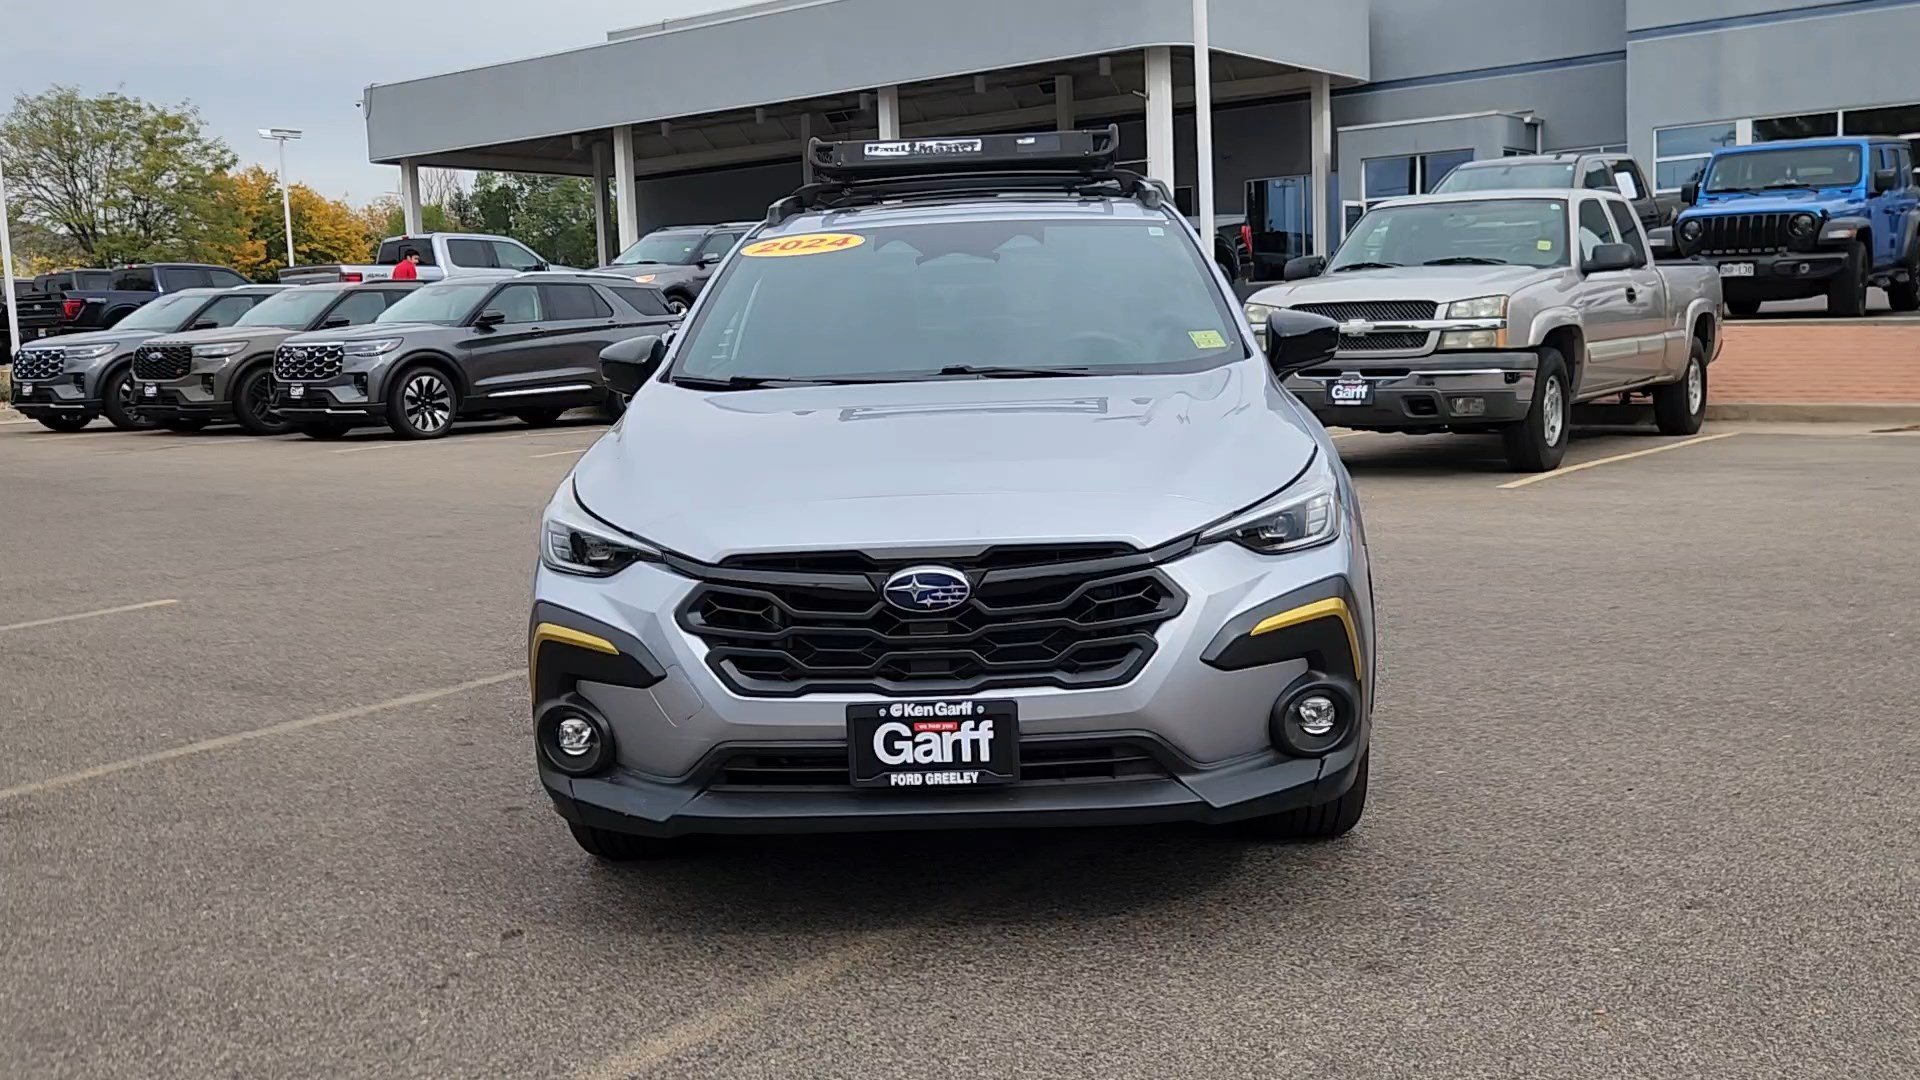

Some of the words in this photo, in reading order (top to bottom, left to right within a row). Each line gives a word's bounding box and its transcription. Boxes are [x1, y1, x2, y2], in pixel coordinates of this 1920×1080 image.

[751, 236, 853, 255] 2024
[1331, 384, 1369, 399] Garff
[903, 703, 934, 717] Ken
[935, 701, 974, 716] Garff
[873, 719, 995, 765] Garff
[890, 773, 923, 786] FORD
[925, 771, 979, 785] GREELEY
